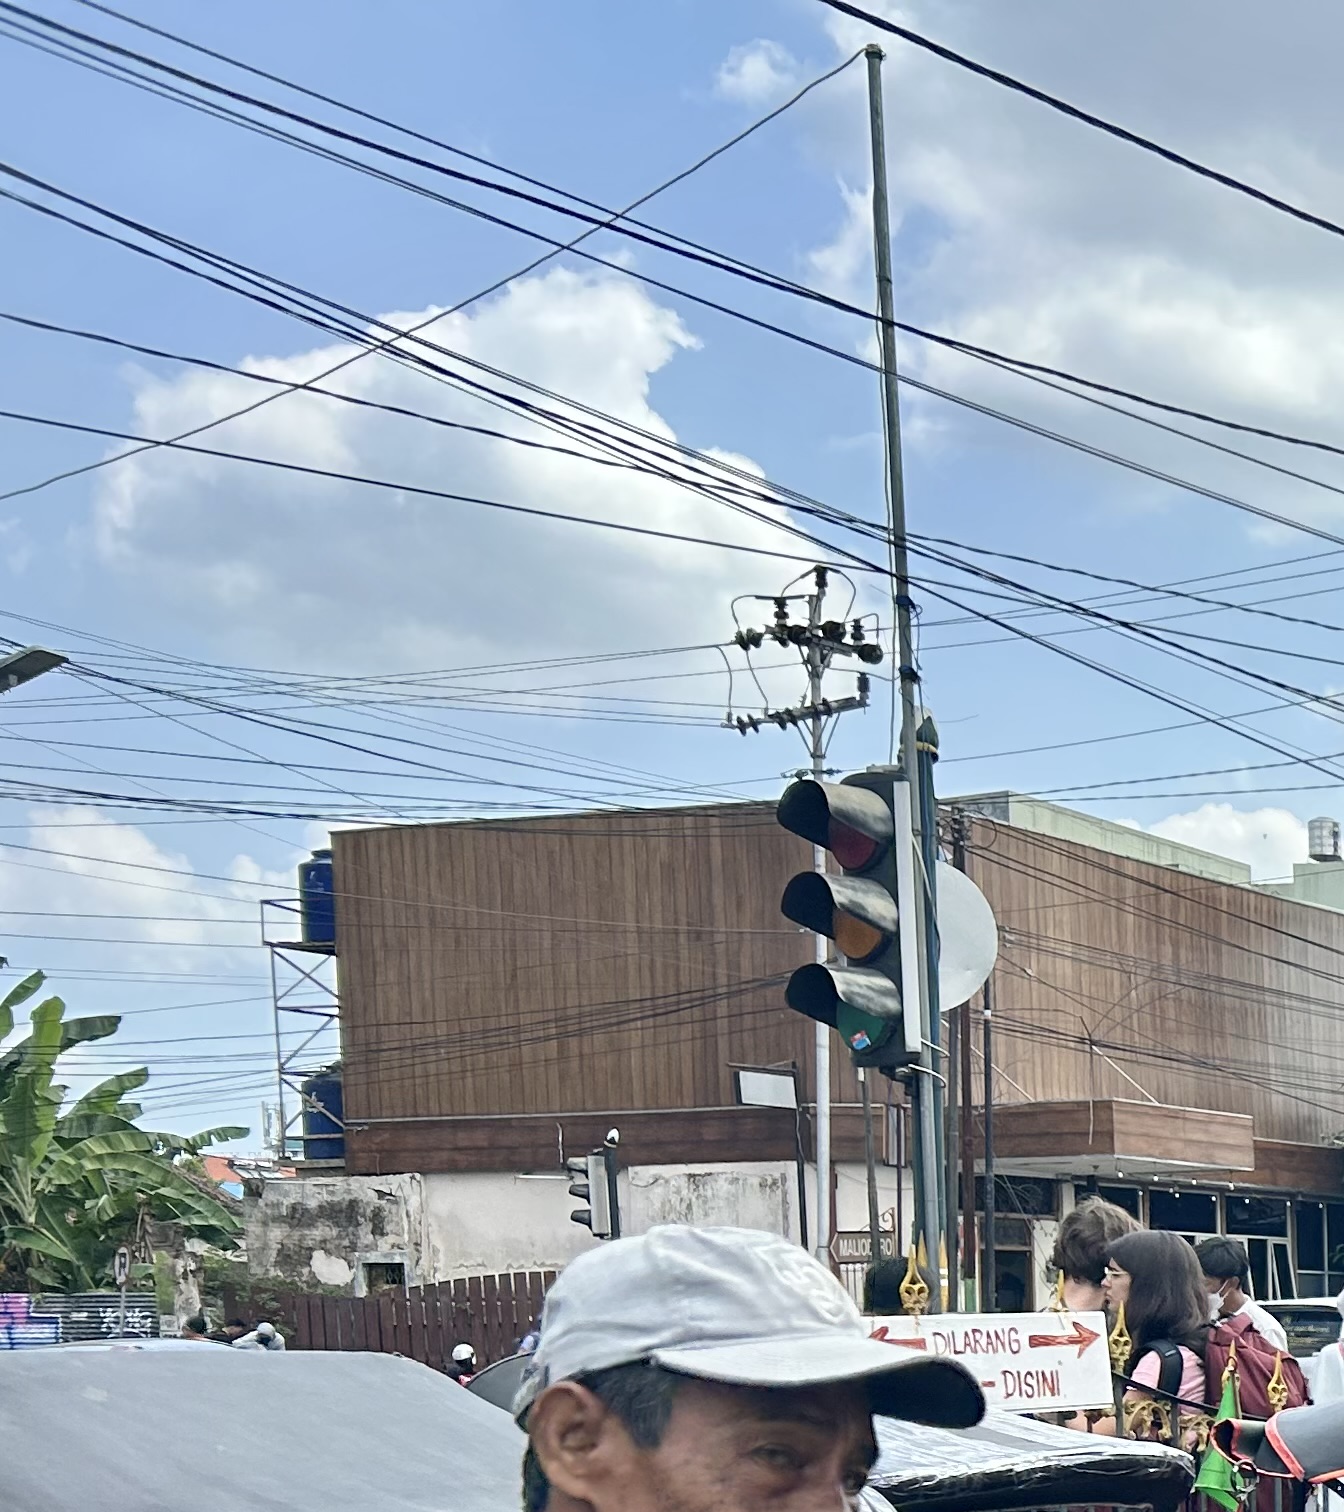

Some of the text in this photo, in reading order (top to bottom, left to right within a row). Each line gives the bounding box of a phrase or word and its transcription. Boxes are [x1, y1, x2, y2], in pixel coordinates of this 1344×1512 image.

[840, 1238, 892, 1256] MALIOBRO
[932, 1327, 1021, 1356] DILARANG
[1001, 1369, 1061, 1399] DISINI
